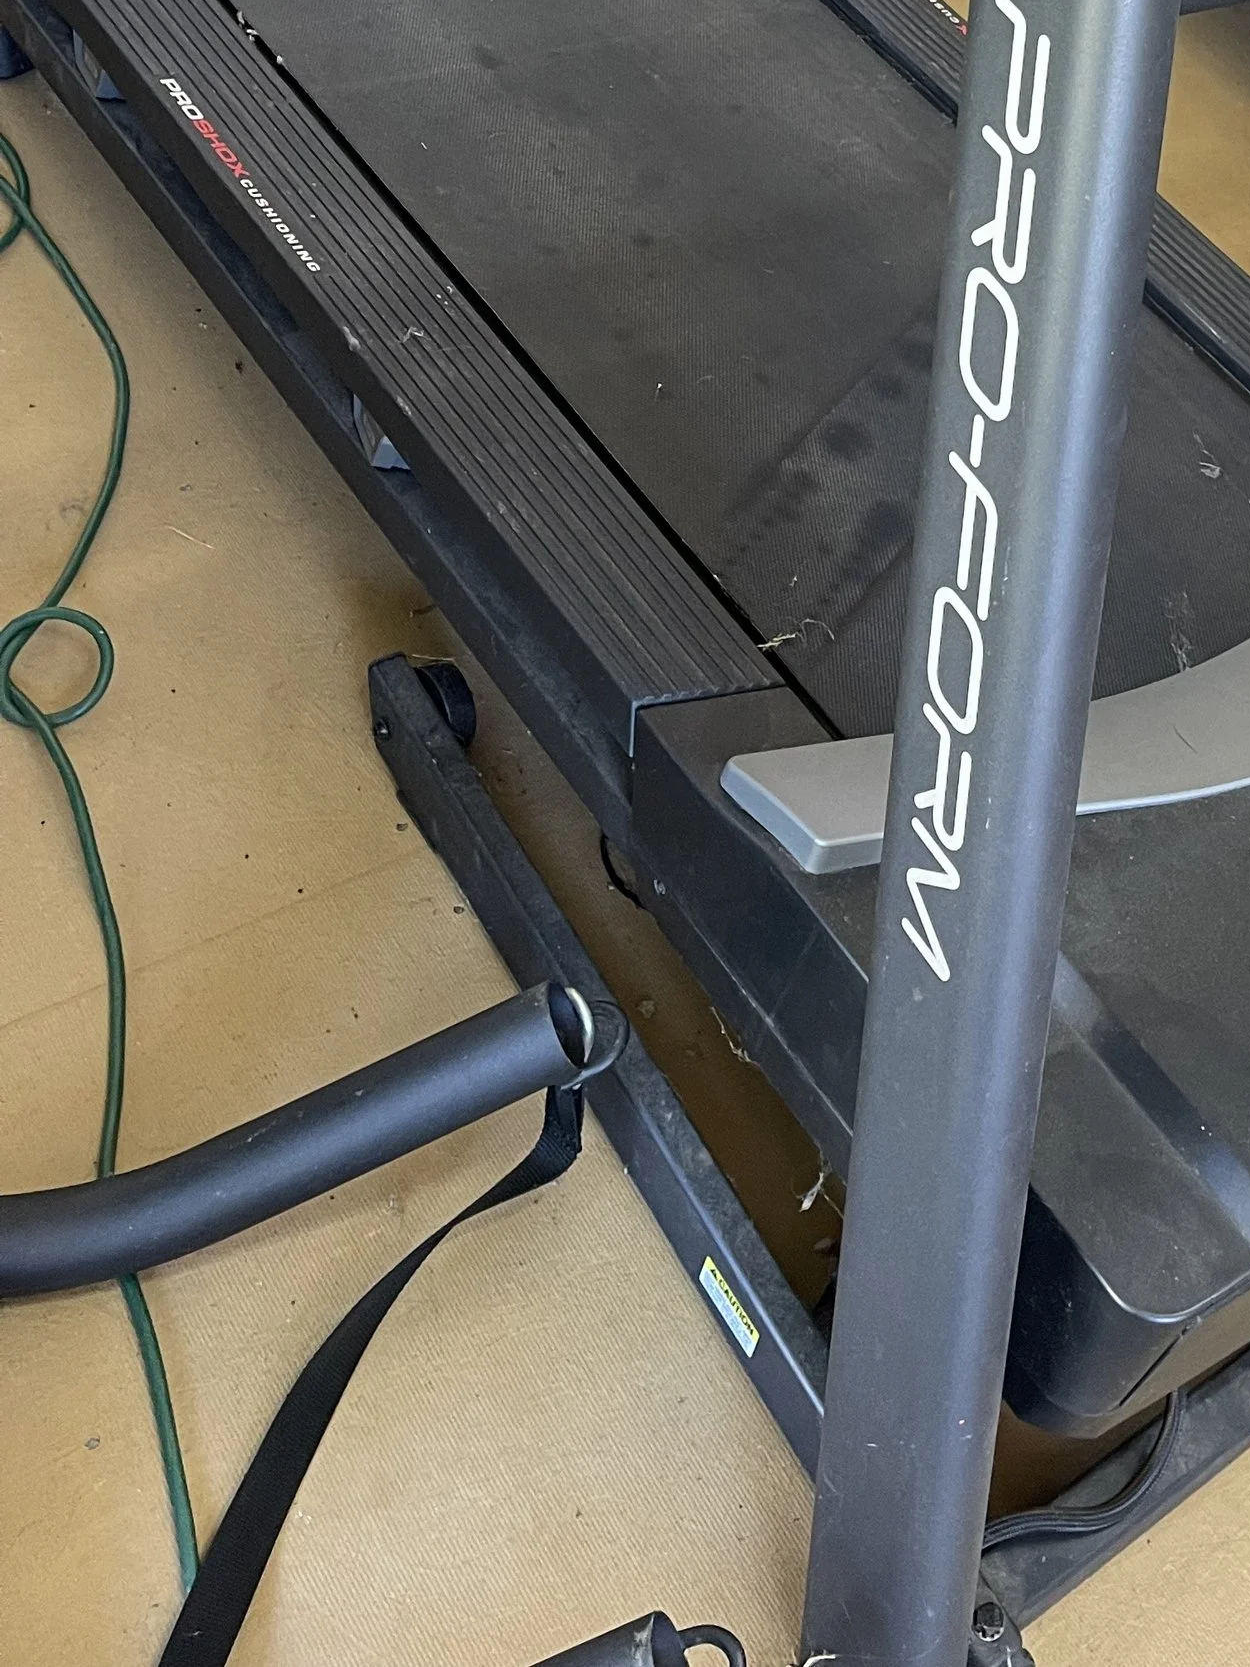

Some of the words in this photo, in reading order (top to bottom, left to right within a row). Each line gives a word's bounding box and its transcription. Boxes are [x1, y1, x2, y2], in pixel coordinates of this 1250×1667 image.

[159, 77, 250, 178] PROSHOX
[239, 178, 321, 273] CUSHIONING
[718, 1278, 755, 1336] CAUTION
